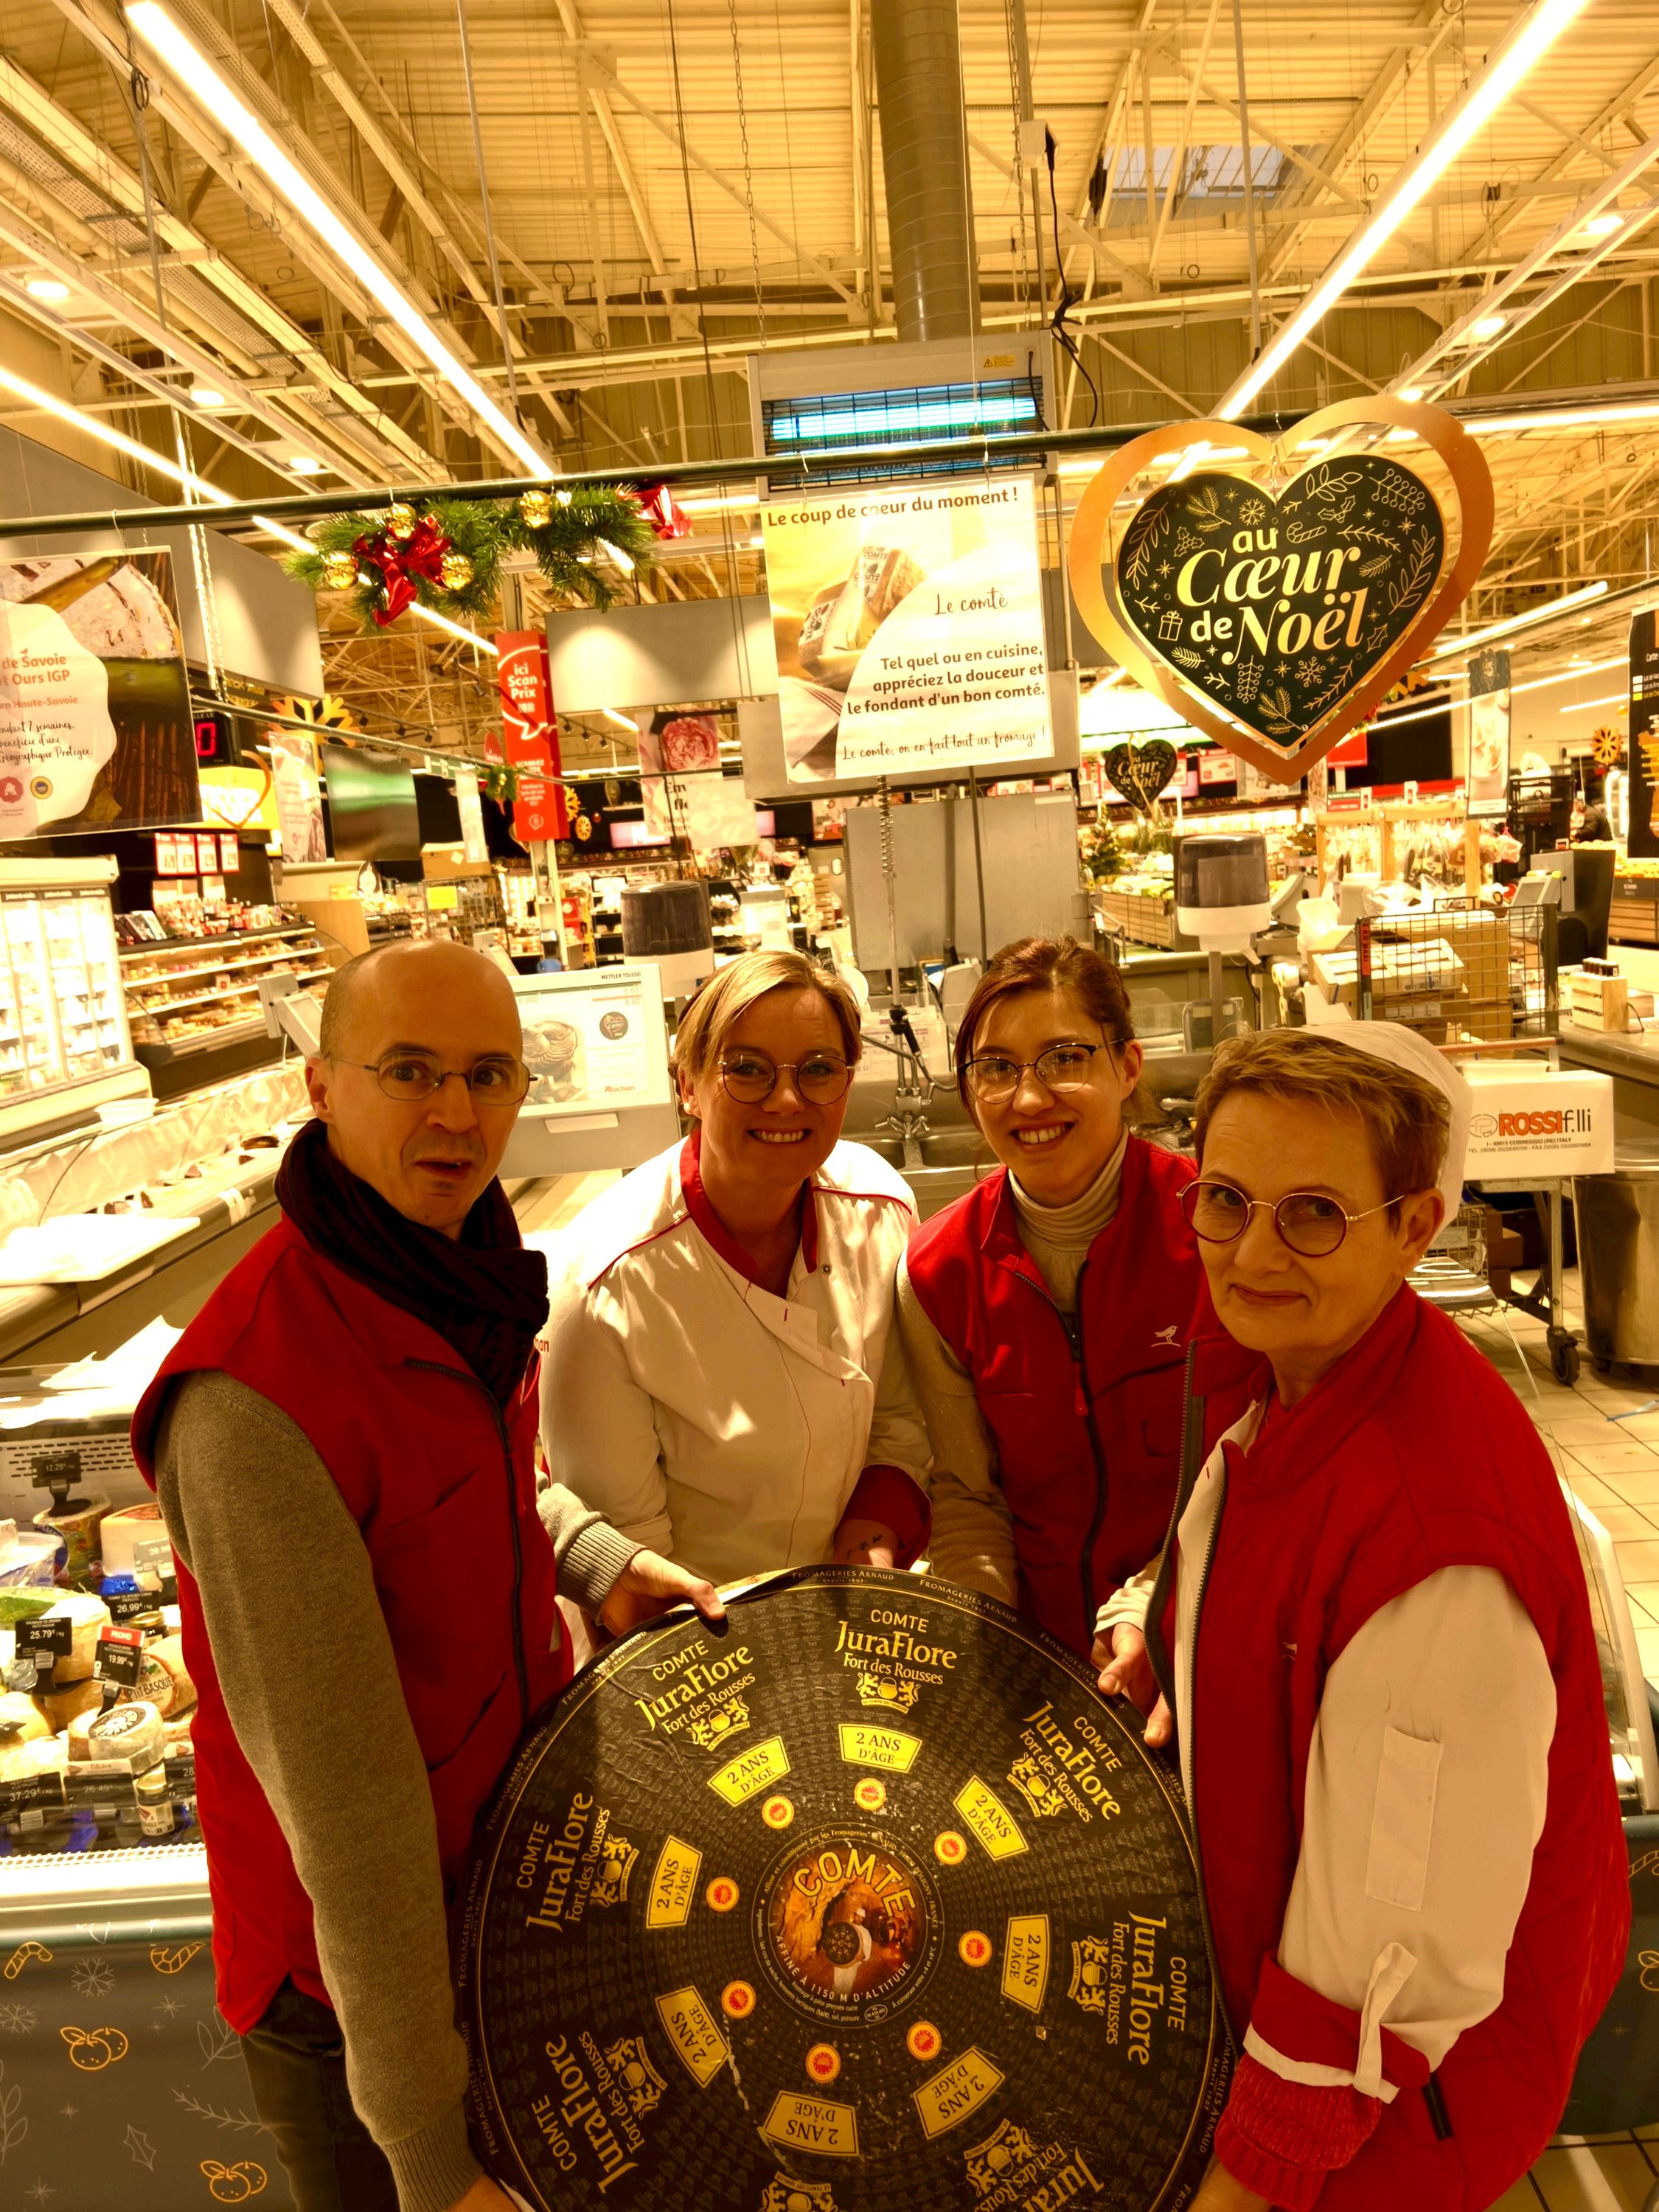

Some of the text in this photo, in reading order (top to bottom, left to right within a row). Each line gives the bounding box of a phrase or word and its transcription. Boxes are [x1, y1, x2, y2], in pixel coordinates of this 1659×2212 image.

[768, 487, 1018, 527] Le coup de coeur du moment !
[1232, 527, 1278, 553] au
[1177, 546, 1361, 607] Cœur
[934, 587, 1009, 616] Le comté
[1190, 587, 1368, 665] de Noël
[2, 653, 66, 669] de Savoie
[880, 644, 1043, 670] Tel quel ou en cuisine,
[12, 674, 44, 685] Ours
[47, 669, 70, 683] IGP
[507, 675, 538, 687] Scan
[511, 687, 536, 700] Prix
[873, 664, 1044, 695] appréciez la douceur et
[13, 696, 78, 709] Haute-Savoie
[847, 683, 1045, 714] le fondant d'un bon comté.
[28, 720, 32, 732] 7
[39, 733, 60, 746] d'une
[843, 745, 855, 760] Le
[899, 745, 911, 754] on
[914, 743, 925, 753] en
[930, 734, 950, 754] fait
[952, 732, 975, 748] tout
[977, 736, 991, 745] un
[994, 731, 1037, 748] fromage
[1120, 777, 1131, 785] de
[605, 1085, 636, 1093] Auchan
[1498, 1110, 1563, 1136] ROSSI
[792, 1570, 857, 1580] FROMAGERIES
[919, 1579, 982, 1606] FROMAGERIES
[111, 1630, 132, 1641] PROMO
[871, 1610, 929, 1633] COMTE
[653, 1640, 709, 1681] COMTE
[834, 1620, 957, 1669] JuraFlore
[142, 1677, 173, 1694] BASQUE
[844, 1652, 944, 1685] Fort des Rousses
[634, 1646, 754, 1732] JuraFlore
[661, 1672, 756, 1735] Fort des Rousses
[856, 1733, 901, 1751] 2 ANS
[858, 1748, 895, 1764] D'ÂGE
[1074, 1717, 1122, 1773] COMTE
[727, 1750, 769, 1785] 2 ANS
[1020, 1728, 1093, 1823] Fort des Rousses
[1022, 1700, 1121, 1820] JuraFlore
[740, 1766, 775, 1793] D'ÂGE
[967, 1807, 997, 1844] D'ÂGE
[975, 1795, 1012, 1838] 2 ANS
[516, 1820, 550, 1888] COMTE
[526, 1792, 594, 1933] JuraFlore
[565, 1809, 611, 1922] Fort des Rousses
[657, 1858, 679, 1909] 2 ANS
[675, 1866, 692, 1907] D'ÂGE
[793, 1848, 917, 1918] COMTE
[776, 1935, 911, 2002] AFFINÉ À 1150 M D'ALTITUDE
[1009, 1936, 1023, 1980] D'ÂGE
[1024, 1933, 1041, 1988] 2 ANS
[1106, 1921, 1130, 2045] Fort des Rousses
[1127, 1910, 1167, 2065] JuraFlore
[1167, 1956, 1187, 2031] COMTE
[671, 2011, 708, 2065] 2 ANS
[689, 2004, 717, 2047] D'ÂGE
[579, 2031, 645, 2154] Fort des Rousses
[931, 2065, 970, 2098] D'ÂGE
[938, 2074, 985, 2120] 2 ANS
[545, 2034, 639, 2194] JuraFlore
[794, 2101, 836, 2123] D'ÂGE
[531, 2094, 577, 2171] COMTE
[786, 2119, 839, 2145] 2 ANS
[1036, 2141, 1068, 2170] Fort
[1013, 2163, 1038, 2188] des
